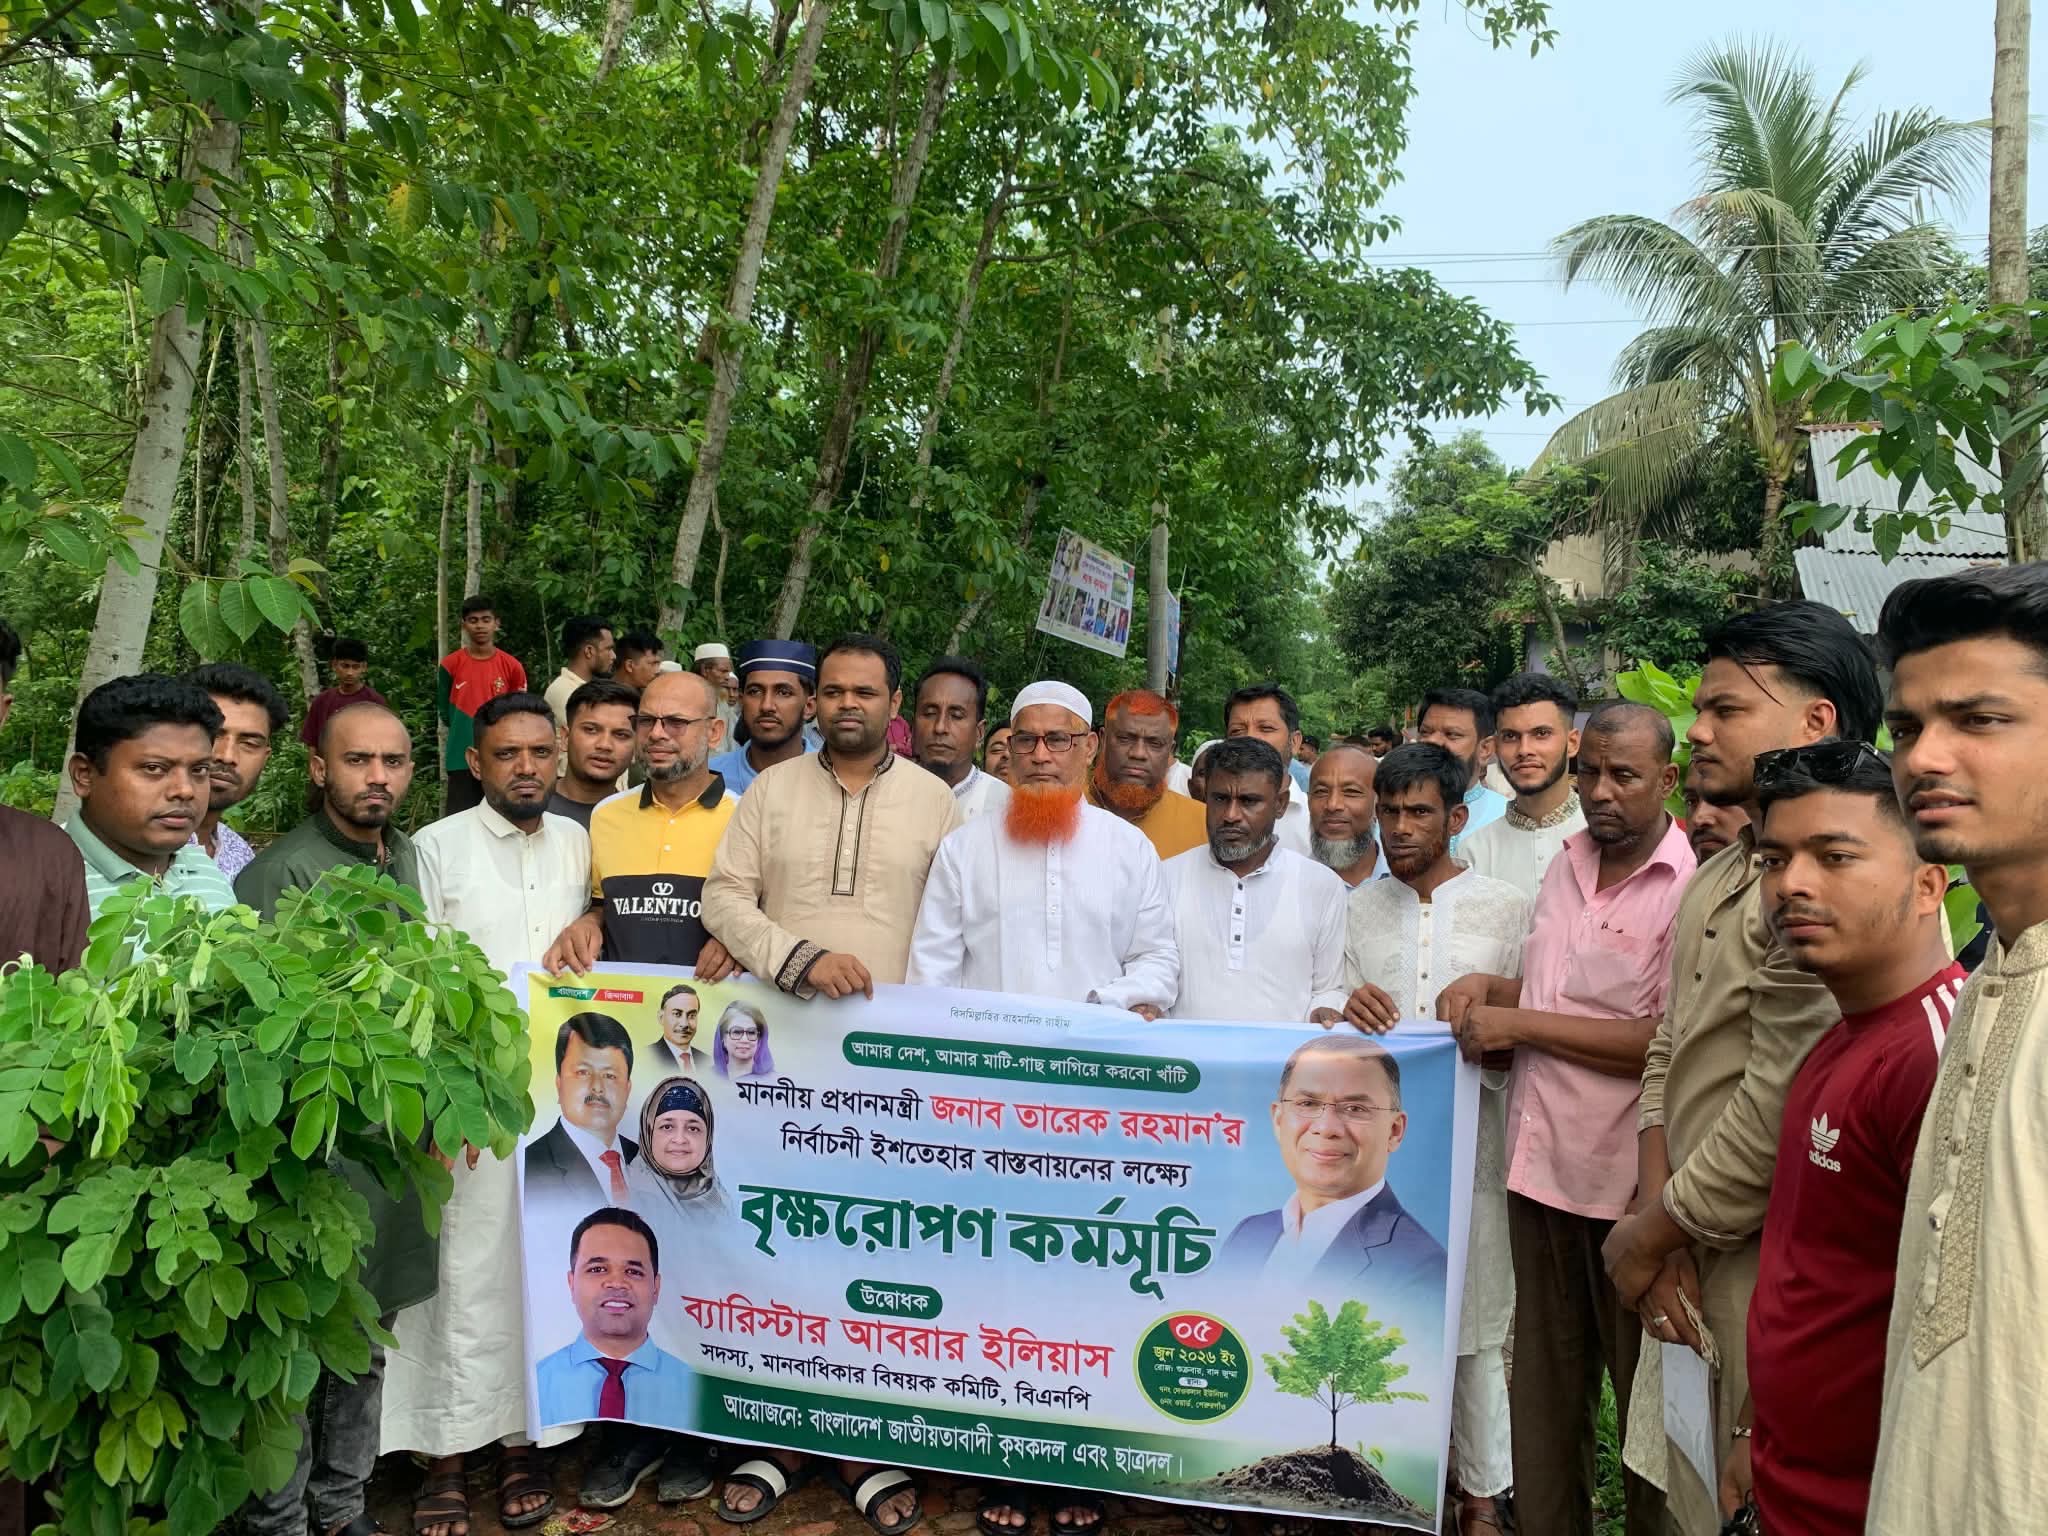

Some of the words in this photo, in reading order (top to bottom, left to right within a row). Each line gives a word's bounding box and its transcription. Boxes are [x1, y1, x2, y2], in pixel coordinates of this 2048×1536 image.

[852, 1040, 892, 1060] আমার
[897, 1045, 930, 1066] দেশ,
[936, 1048, 977, 1068] আমার
[983, 1050, 1044, 1075] মাটি-গাছ
[1050, 1057, 1100, 1079] লাগিয়ে
[1106, 1061, 1151, 1084] করবো
[1156, 1064, 1189, 1085] খাঁটি
[736, 1079, 812, 1110] মাননীয়
[821, 1087, 923, 1122] প্রধানমন্ত্রী
[929, 1095, 1004, 1130] জনাব
[1016, 1103, 1108, 1138] তারেক
[781, 1122, 864, 1159] নির্বাচনী
[869, 1136, 976, 1172] ইশতেহার
[984, 1152, 1114, 1182] বাস্তবায়নের
[1123, 1160, 1192, 1188] লক্ষ্যে
[1809, 1150, 1841, 1172] adidas
[738, 1184, 997, 1258] বৃক্ষরোপণ
[1005, 1197, 1216, 1300] কর্মসূচি
[859, 1283, 930, 1313] উদ্বোধক
[681, 1293, 831, 1346] ব্যারিস্টার
[840, 1317, 968, 1363] আবরার
[979, 1323, 1116, 1378] ইলিয়াস
[1153, 1346, 1175, 1363] জুন
[1179, 1349, 1216, 1364] ২০২৬
[1220, 1348, 1236, 1367] ইং
[1176, 1321, 1213, 1342] ০৫
[700, 1342, 754, 1374] সদস্য,
[761, 1352, 867, 1384] মানবাধিকার
[872, 1364, 937, 1393] বিষয়ক
[943, 1374, 1007, 1406] কমিটি,
[1015, 1383, 1092, 1411] বিএনপি
[808, 1408, 883, 1440] বাংলাদেশ
[888, 1416, 994, 1456] জাতীয়তাবাদী
[997, 1432, 1065, 1469] কৃষকদল
[1073, 1443, 1109, 1472] এবং
[1114, 1445, 1174, 1478] ছাত্রদল
